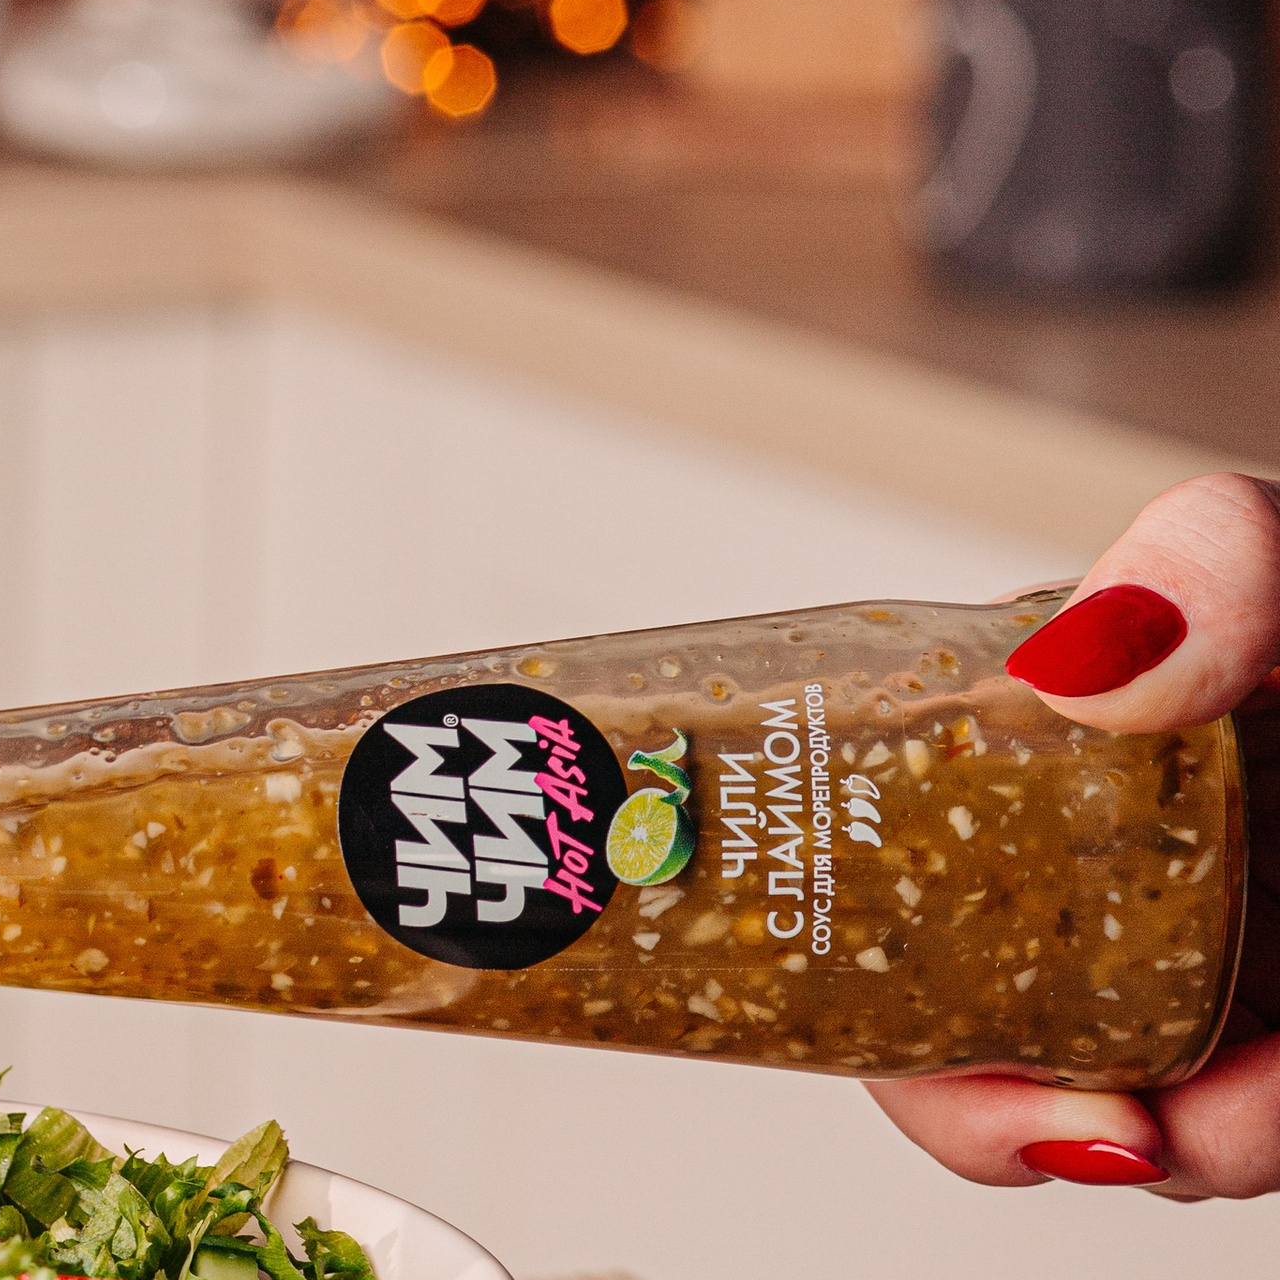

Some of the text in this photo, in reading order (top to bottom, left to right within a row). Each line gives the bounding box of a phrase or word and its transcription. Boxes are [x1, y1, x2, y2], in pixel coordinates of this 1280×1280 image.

[461, 718, 548, 922] ЧИМ
[719, 753, 758, 878] ЧИЛИ
[757, 698, 805, 938] С ЛАЙМОМ
[804, 683, 834, 955] СОУС ДЛЯ МОРЕПРОДУКТОВ
